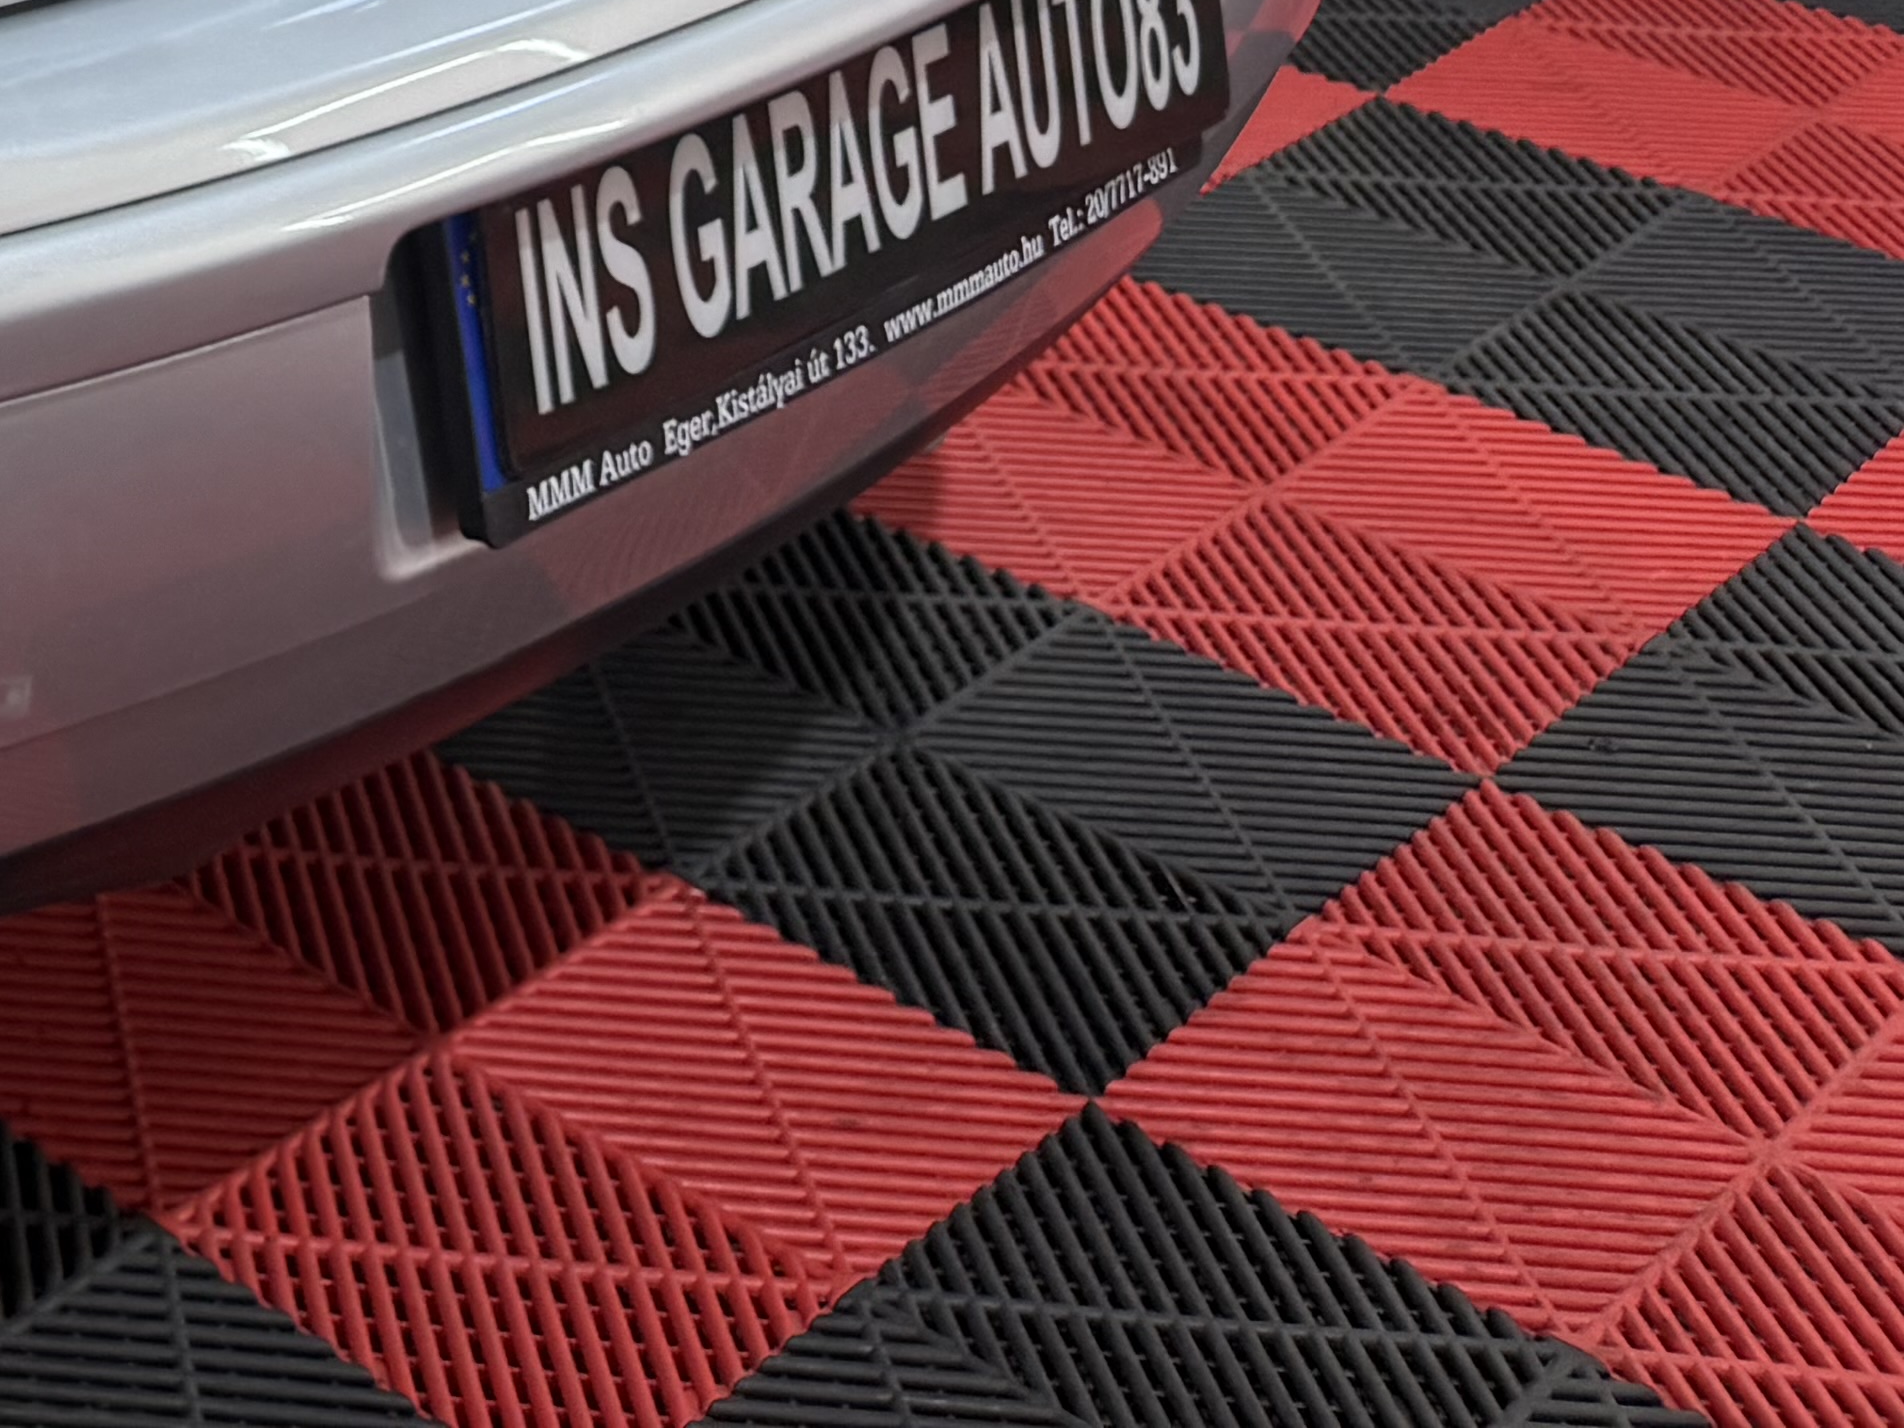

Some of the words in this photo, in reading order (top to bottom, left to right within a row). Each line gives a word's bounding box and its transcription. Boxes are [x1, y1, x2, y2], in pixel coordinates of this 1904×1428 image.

[514, 161, 658, 415] INS
[668, 23, 966, 340] GARAGE
[526, 458, 596, 522] MMM
[599, 440, 654, 486] Auto
[807, 351, 830, 384] út
[832, 325, 877, 371] 133.
[883, 235, 1045, 343] www.mmmauto.hu
[1084, 147, 1179, 225] 20/7717-891
